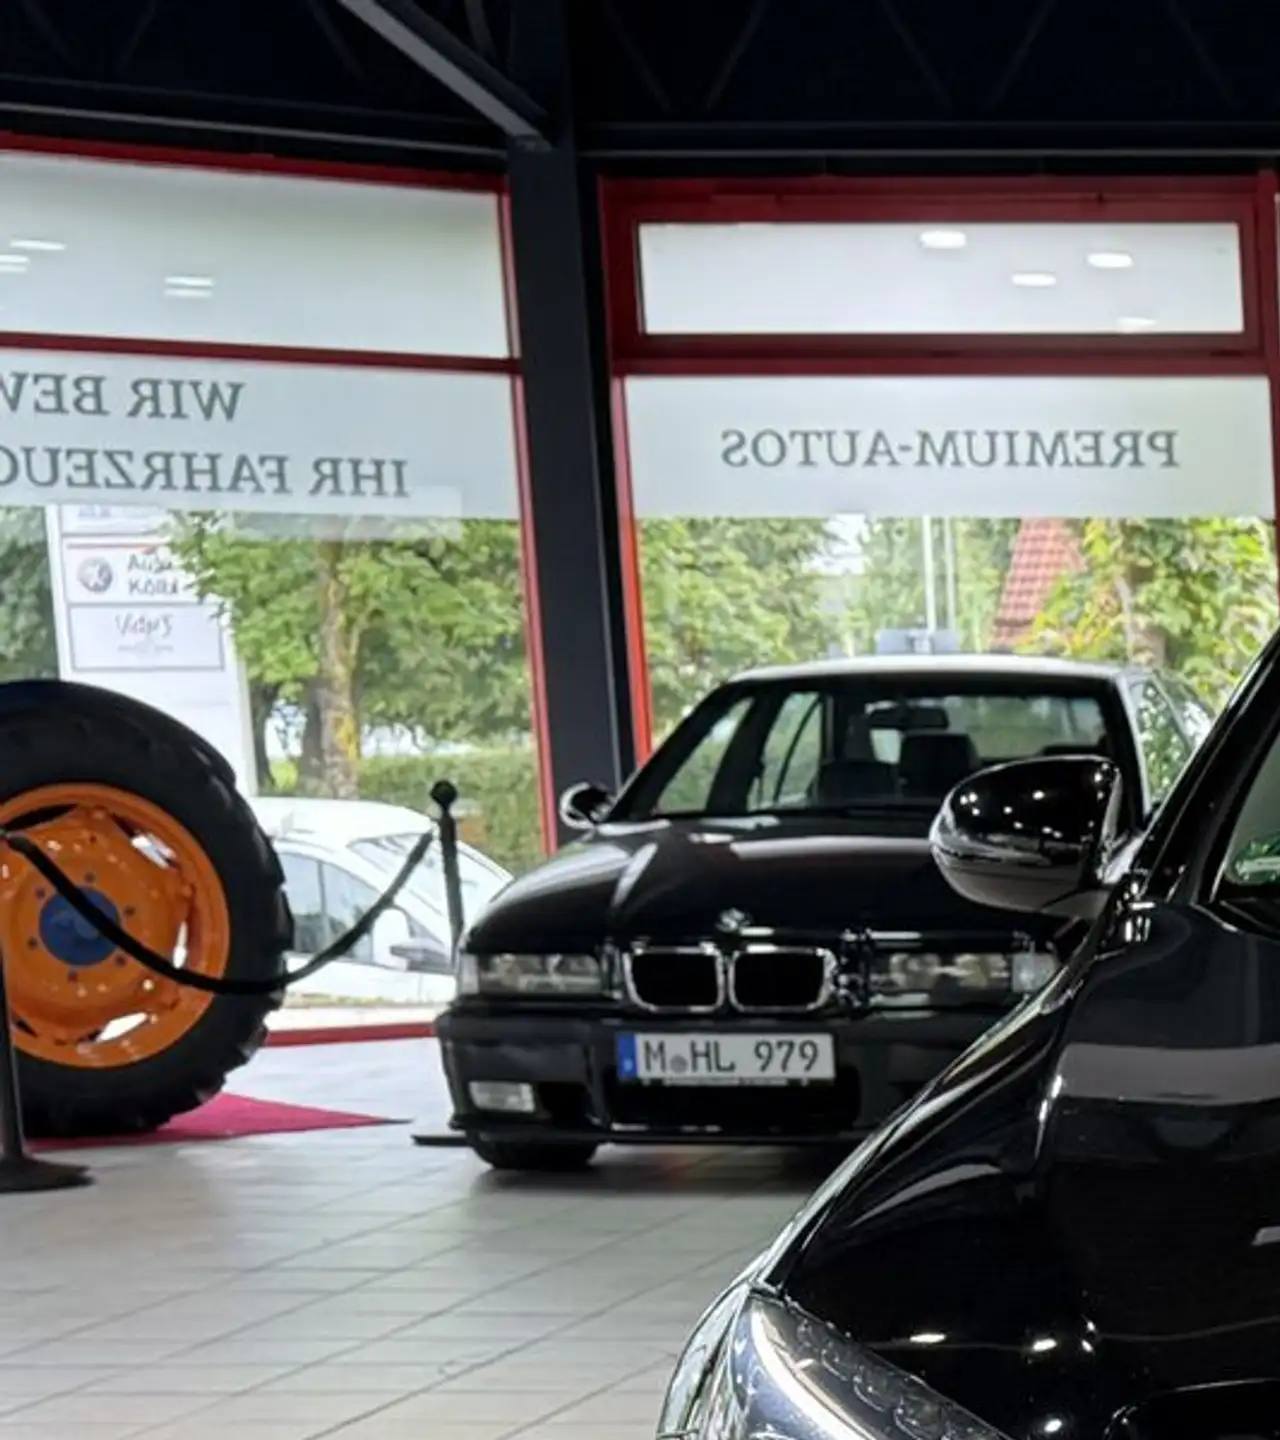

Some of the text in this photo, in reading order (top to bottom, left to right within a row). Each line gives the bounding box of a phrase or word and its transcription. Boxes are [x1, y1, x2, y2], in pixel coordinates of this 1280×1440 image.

[643, 1039, 819, 1073] M HL 979
